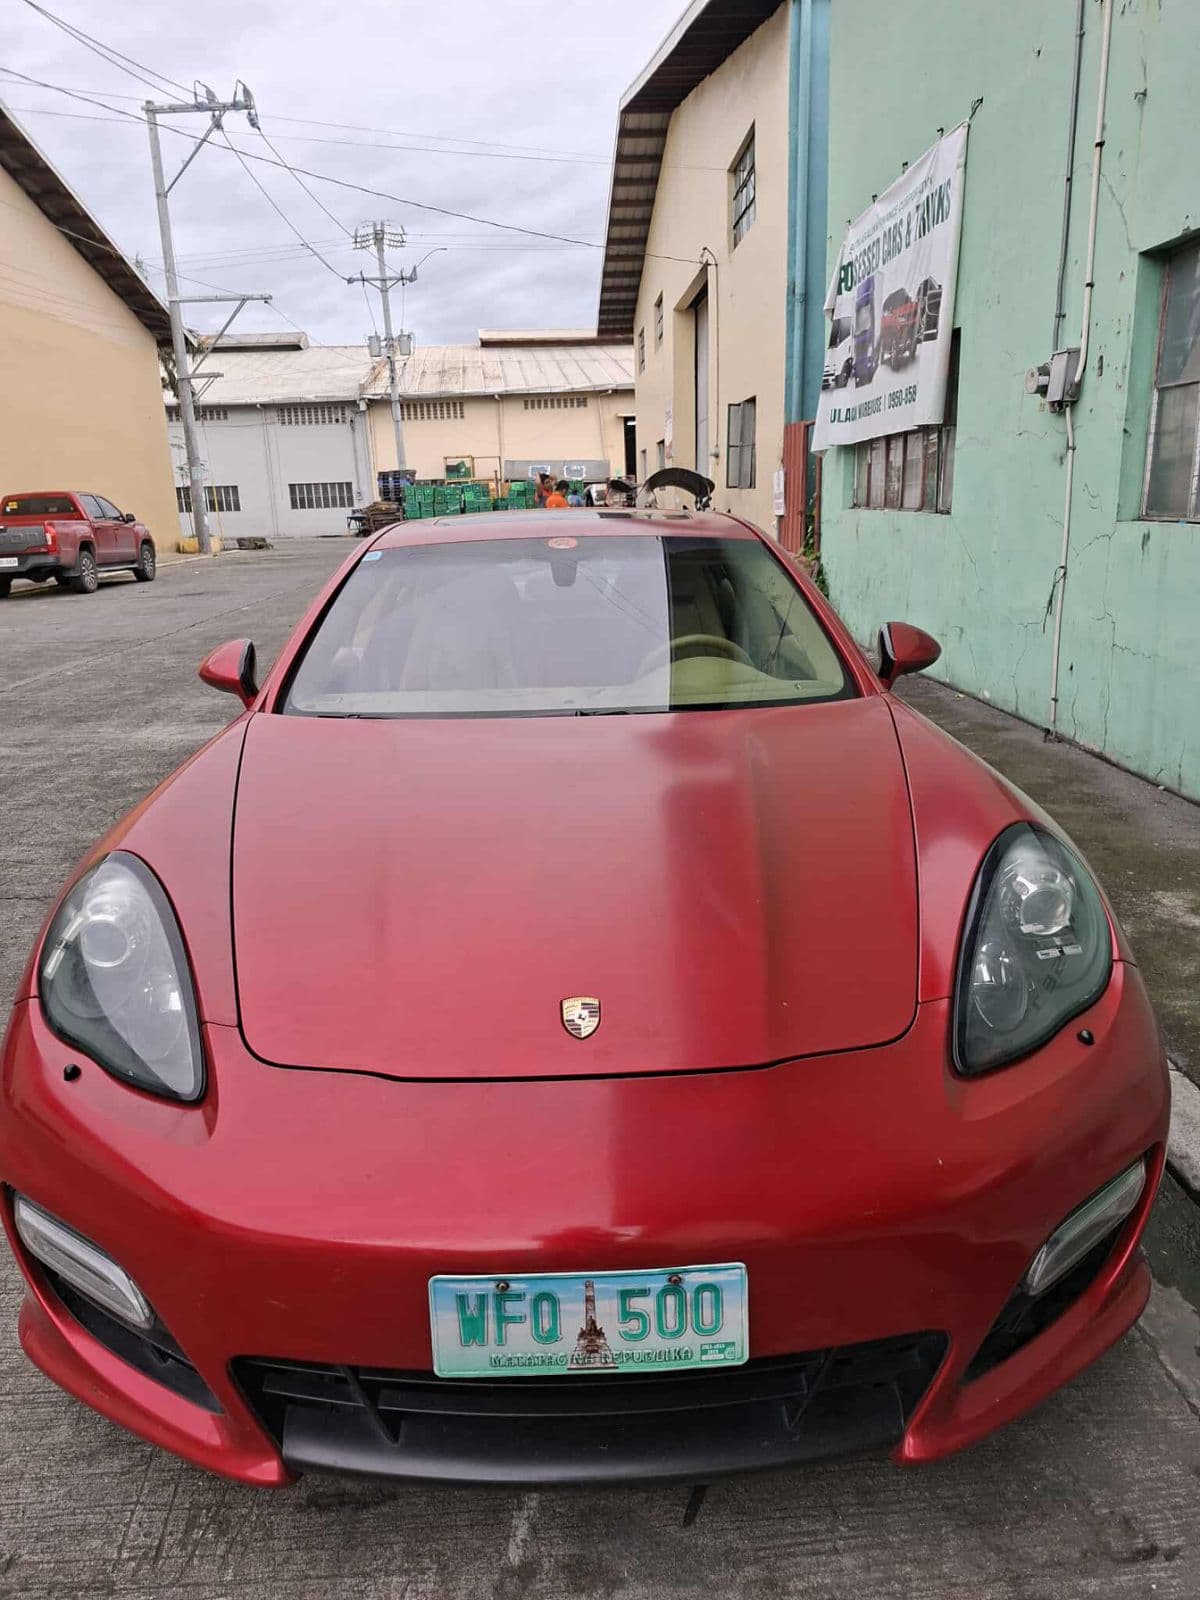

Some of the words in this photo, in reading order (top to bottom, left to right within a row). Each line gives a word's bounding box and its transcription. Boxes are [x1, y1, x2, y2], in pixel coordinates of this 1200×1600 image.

[882, 217, 903, 266] CARS
[905, 210, 912, 249] &
[455, 1290, 563, 1347] WFQ
[616, 1282, 724, 1342] 500
[490, 1352, 568, 1367] MATATAG
[570, 1352, 595, 1366] NA
[600, 1346, 694, 1364] REPUBLIKA
